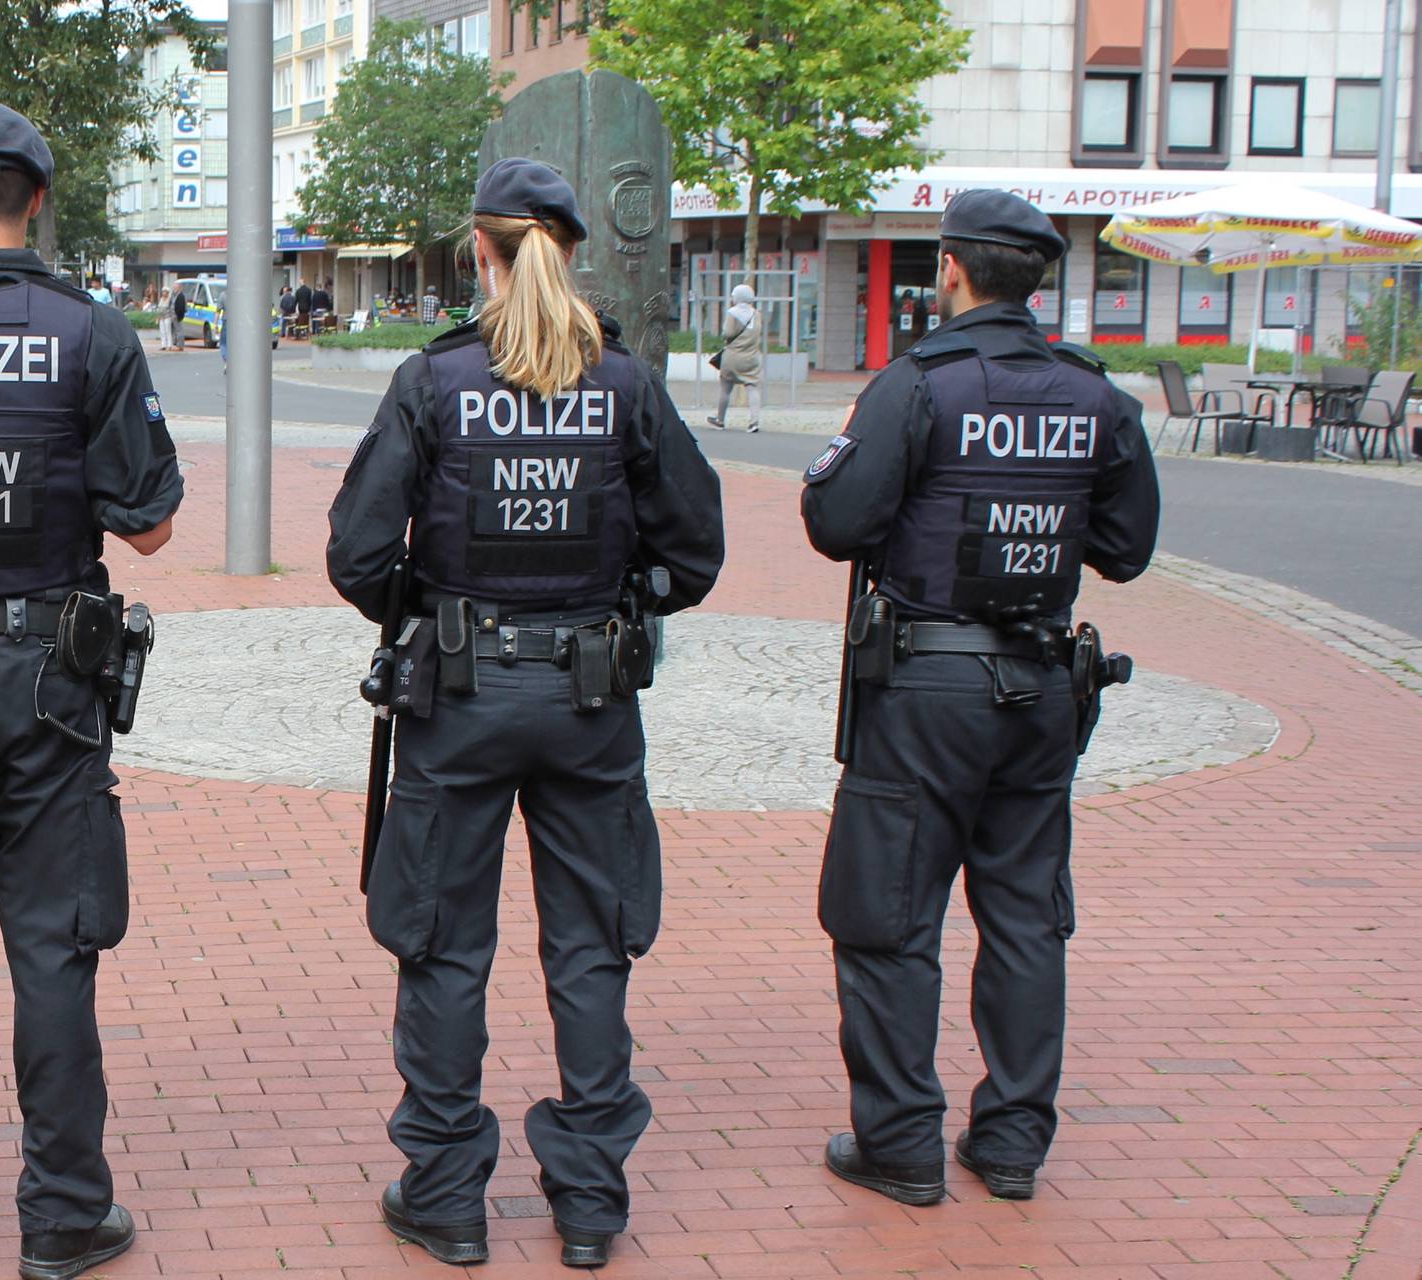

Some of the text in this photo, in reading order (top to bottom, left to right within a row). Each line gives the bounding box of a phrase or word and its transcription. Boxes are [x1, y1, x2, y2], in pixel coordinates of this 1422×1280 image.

[1064, 190, 1196, 207] APOTHEK
[460, 390, 614, 436] POLIZEI
[960, 413, 1097, 459] POLIZEI
[493, 457, 580, 491] NRW
[497, 497, 569, 531] 1231
[987, 502, 1066, 534] NRW
[1000, 541, 1062, 575] 1231
